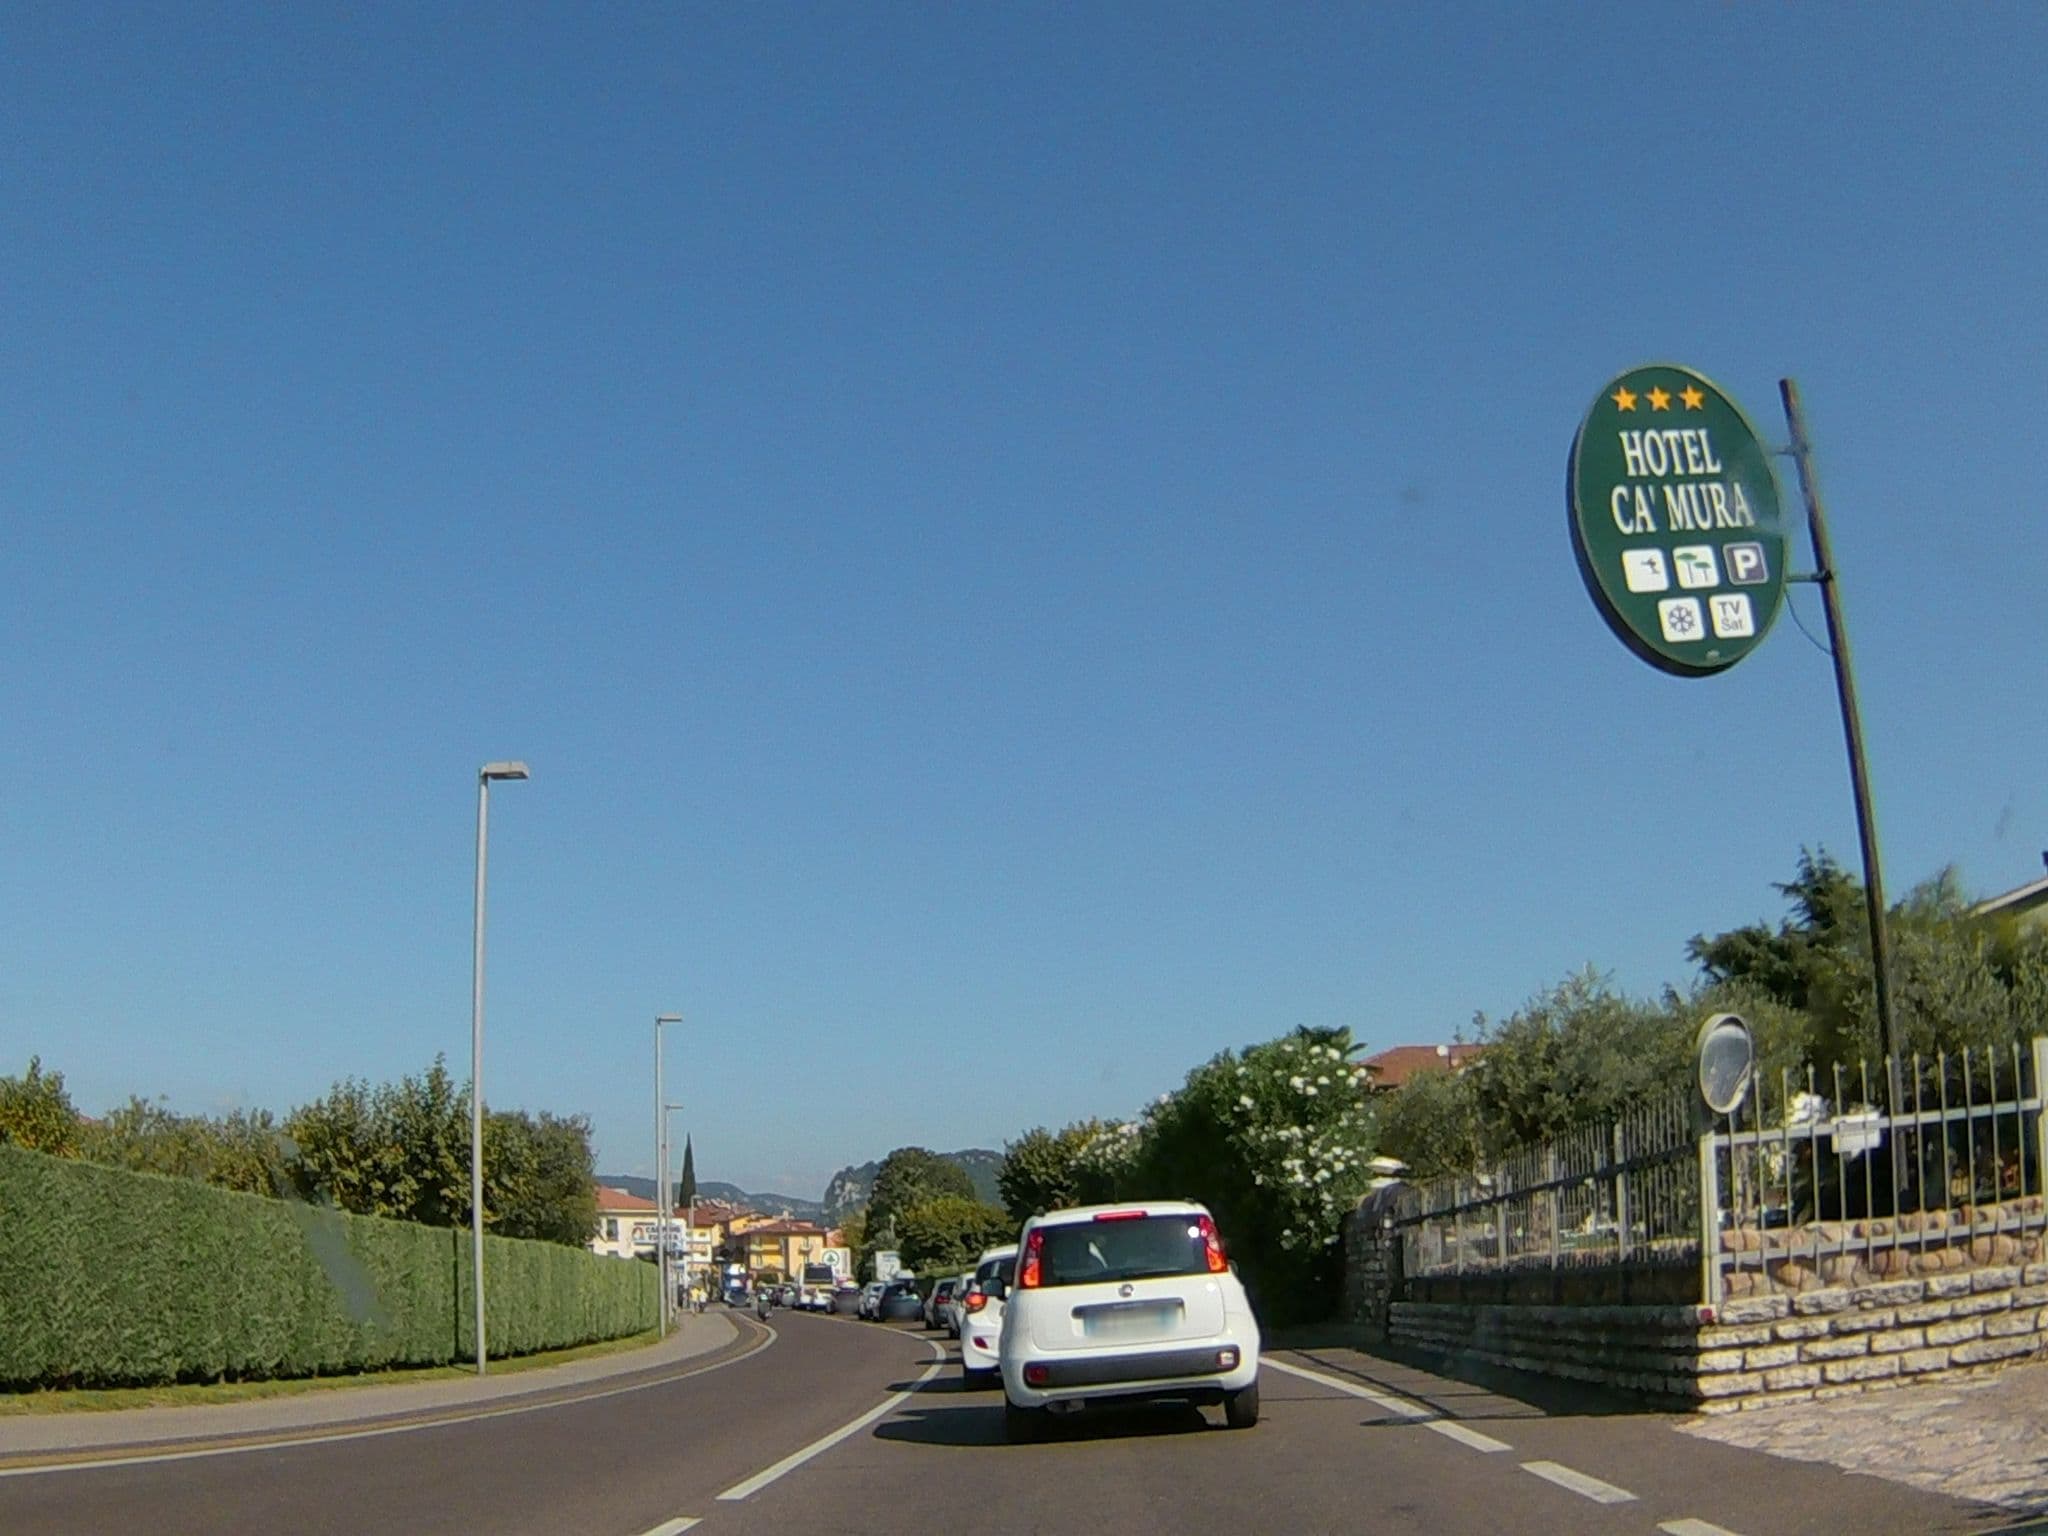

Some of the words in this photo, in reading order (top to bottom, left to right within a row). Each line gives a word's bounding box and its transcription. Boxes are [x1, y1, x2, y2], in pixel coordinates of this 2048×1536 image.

[1619, 428, 1721, 476] HOTEL
[1611, 483, 1656, 534] CA'
[1663, 483, 1755, 530] MURA
[1733, 549, 1758, 579] P
[1718, 600, 1741, 617] TV
[1720, 617, 1744, 632] Sat
